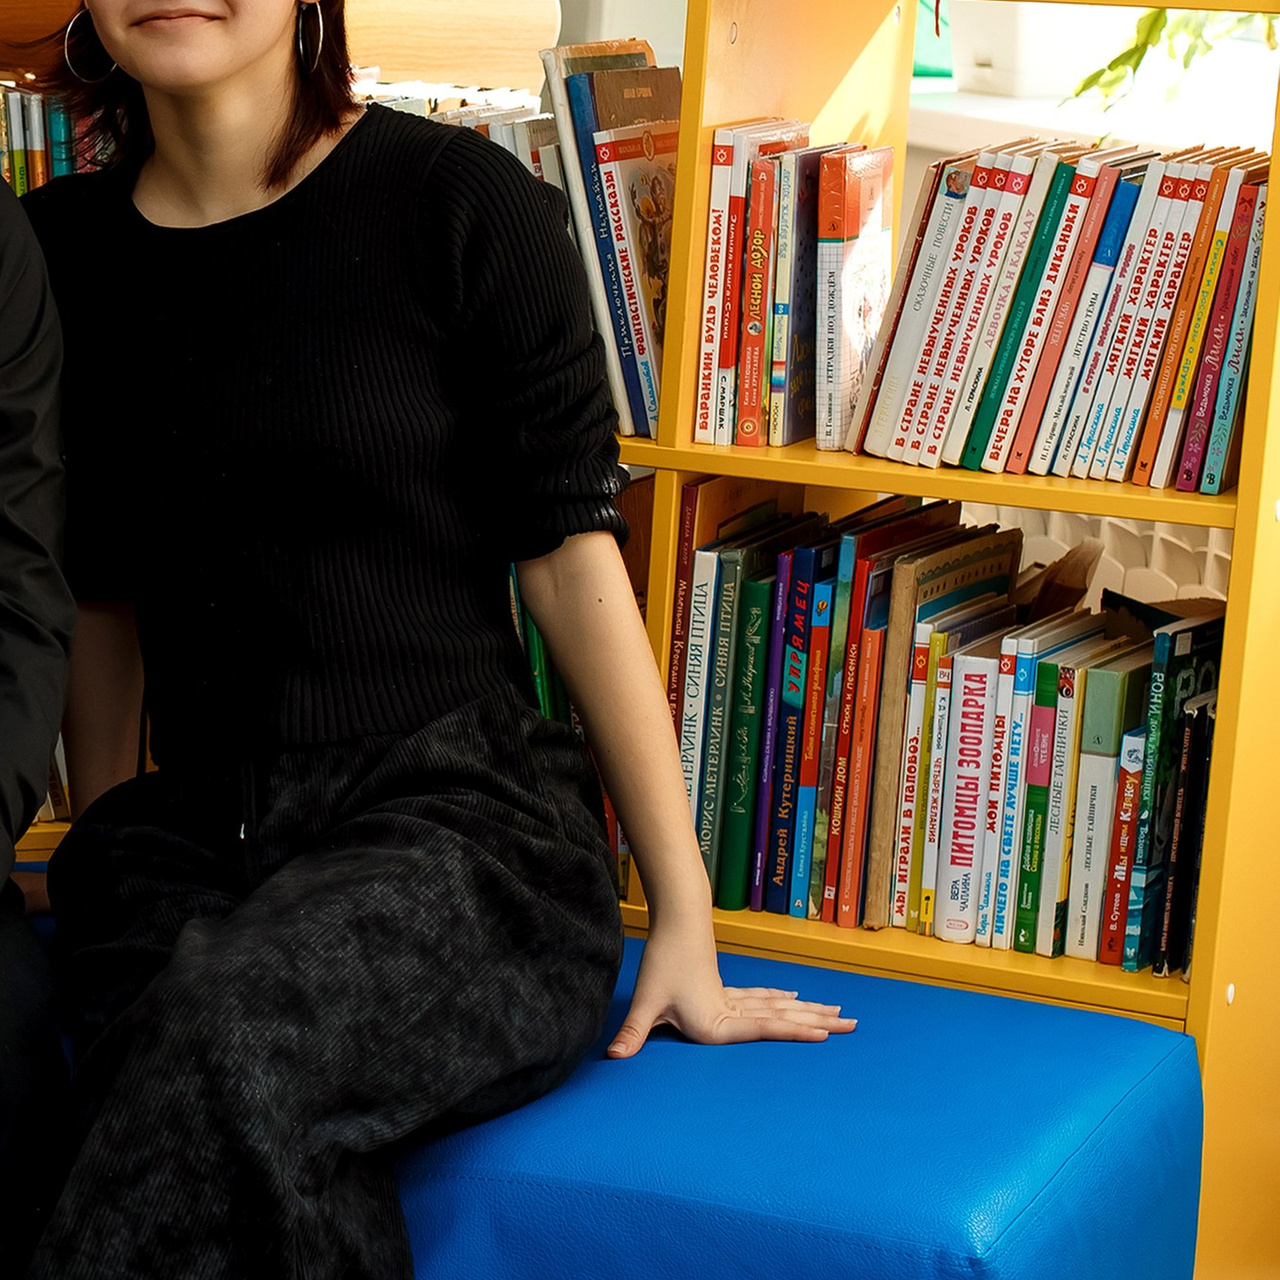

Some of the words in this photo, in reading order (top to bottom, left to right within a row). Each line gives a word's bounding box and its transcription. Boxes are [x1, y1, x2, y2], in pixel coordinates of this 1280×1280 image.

[1129, 229, 1158, 304] ХАРАКТЕР
[705, 305, 715, 343] БУДЬ
[826, 315, 836, 334] ПОД
[899, 381, 924, 432] СТРАНЕ
[913, 267, 957, 375] НЕВЫУЧЕННЫХ
[951, 206, 978, 262] УРОКОВ
[989, 409, 1014, 461] ВЕЧЕРА
[1011, 330, 1038, 382] ХУТОРЕ
[1045, 204, 1079, 284] ДИКАНЬКИ
[826, 338, 835, 384] ТЕТРАДКИ
[773, 829, 788, 886] Андрей
[787, 579, 810, 694] УПРЯМЕЦ
[957, 672, 988, 768] ЗООПАРКА
[950, 776, 977, 867] ПИТОМЦЫ
[950, 878, 961, 902] ВЕРА
[959, 872, 971, 912] ЧАПЛИНА
